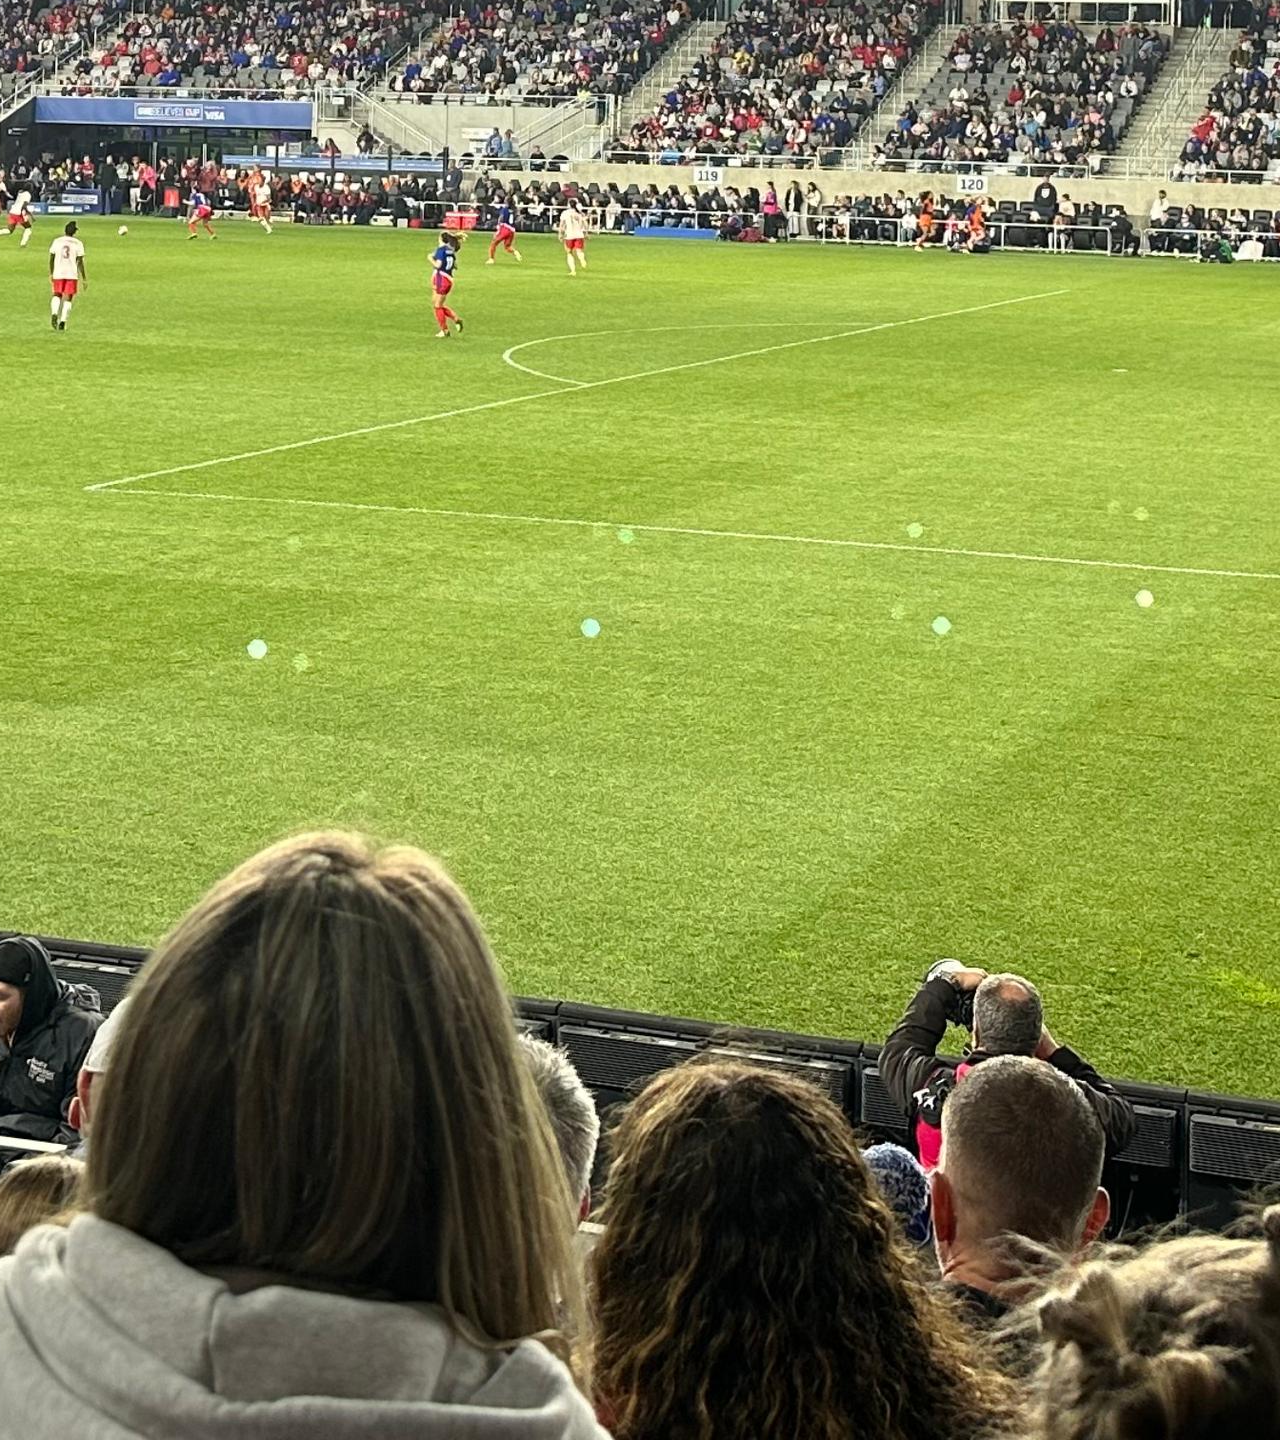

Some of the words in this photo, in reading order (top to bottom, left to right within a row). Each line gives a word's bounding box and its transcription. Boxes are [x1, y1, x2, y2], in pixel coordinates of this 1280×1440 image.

[204, 110, 226, 121] VISA
[697, 170, 718, 182] 119
[960, 179, 984, 190] 120
[62, 245, 71, 259] 3
